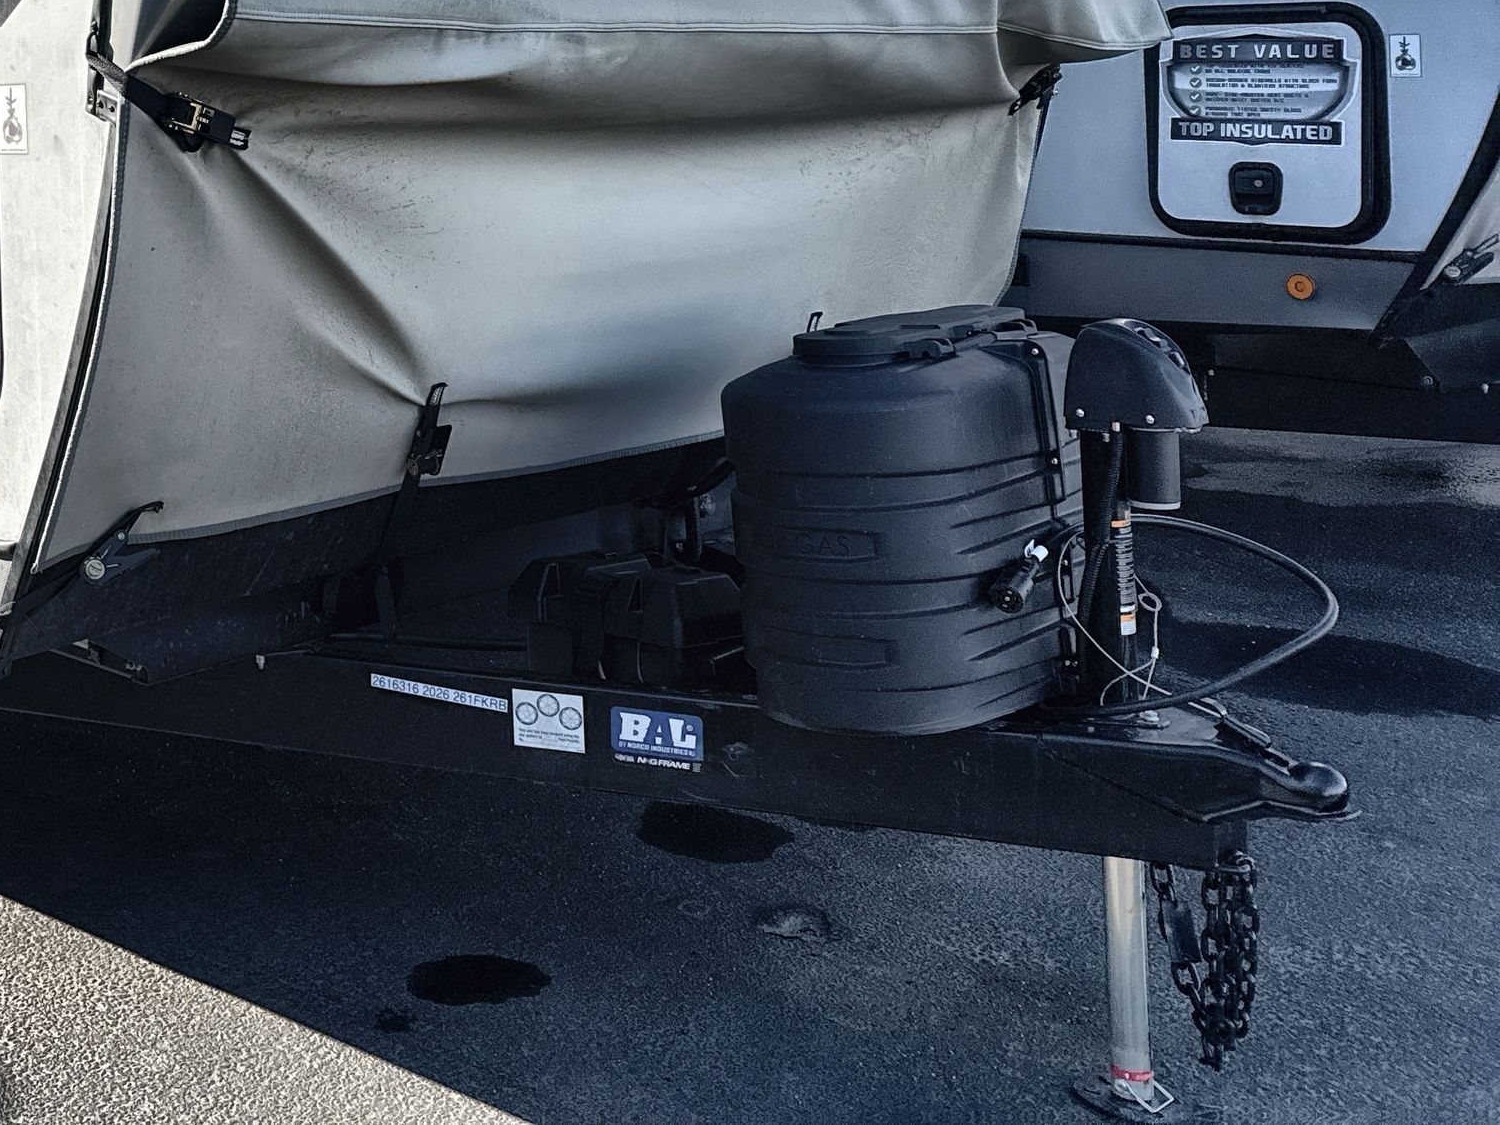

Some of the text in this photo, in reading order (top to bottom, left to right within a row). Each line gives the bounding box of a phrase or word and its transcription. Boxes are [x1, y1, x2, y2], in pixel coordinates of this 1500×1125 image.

[1179, 44, 1335, 59] BEST VALUE
[1178, 121, 1333, 141] TOP INSULATED
[796, 535, 851, 556] GAS
[372, 676, 507, 711] 2616316 2026 261FKRB
[619, 712, 697, 749] BAL
[627, 741, 650, 751] NORCO
[650, 745, 689, 756] INDUSTRIES
[658, 759, 691, 770] FRAME
